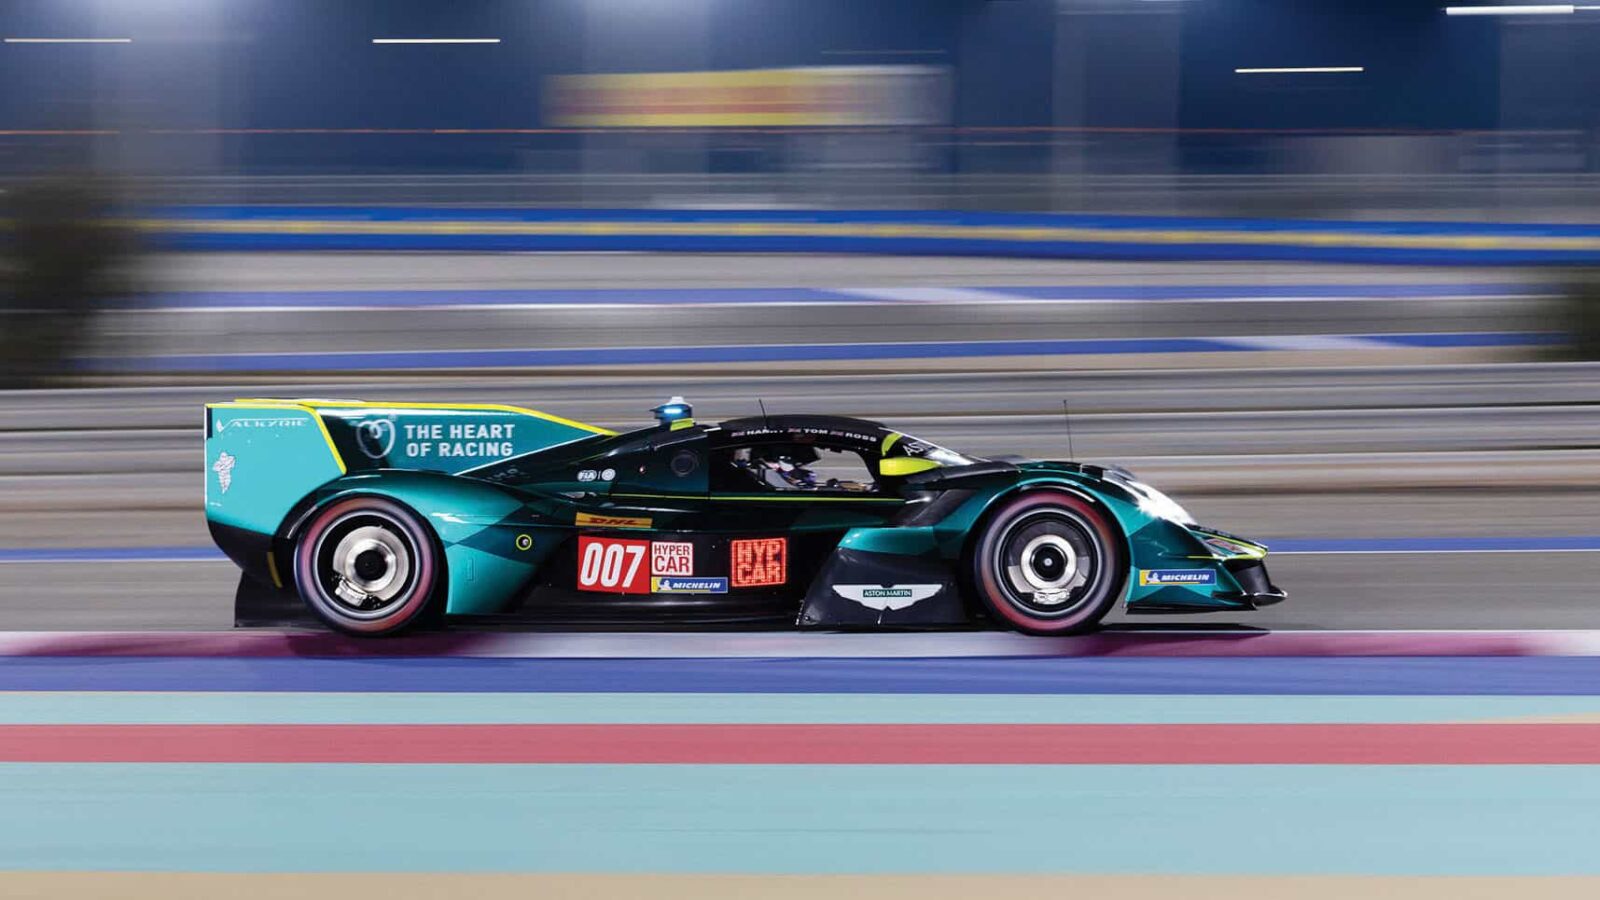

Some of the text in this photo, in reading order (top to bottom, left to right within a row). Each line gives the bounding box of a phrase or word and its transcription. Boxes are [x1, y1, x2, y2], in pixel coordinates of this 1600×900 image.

[215, 416, 309, 433] VALKYRIE
[404, 424, 516, 439] THE HEART
[804, 427, 829, 435] TOM
[845, 432, 877, 442] ROSS
[405, 441, 514, 457] OF RACING
[654, 544, 691, 556] HYPER
[580, 542, 646, 587] 007
[654, 555, 691, 573] CAR
[736, 561, 782, 584] CAR
[1160, 573, 1211, 581] MICHELIN
[864, 588, 912, 598] ASTON MARTIN
